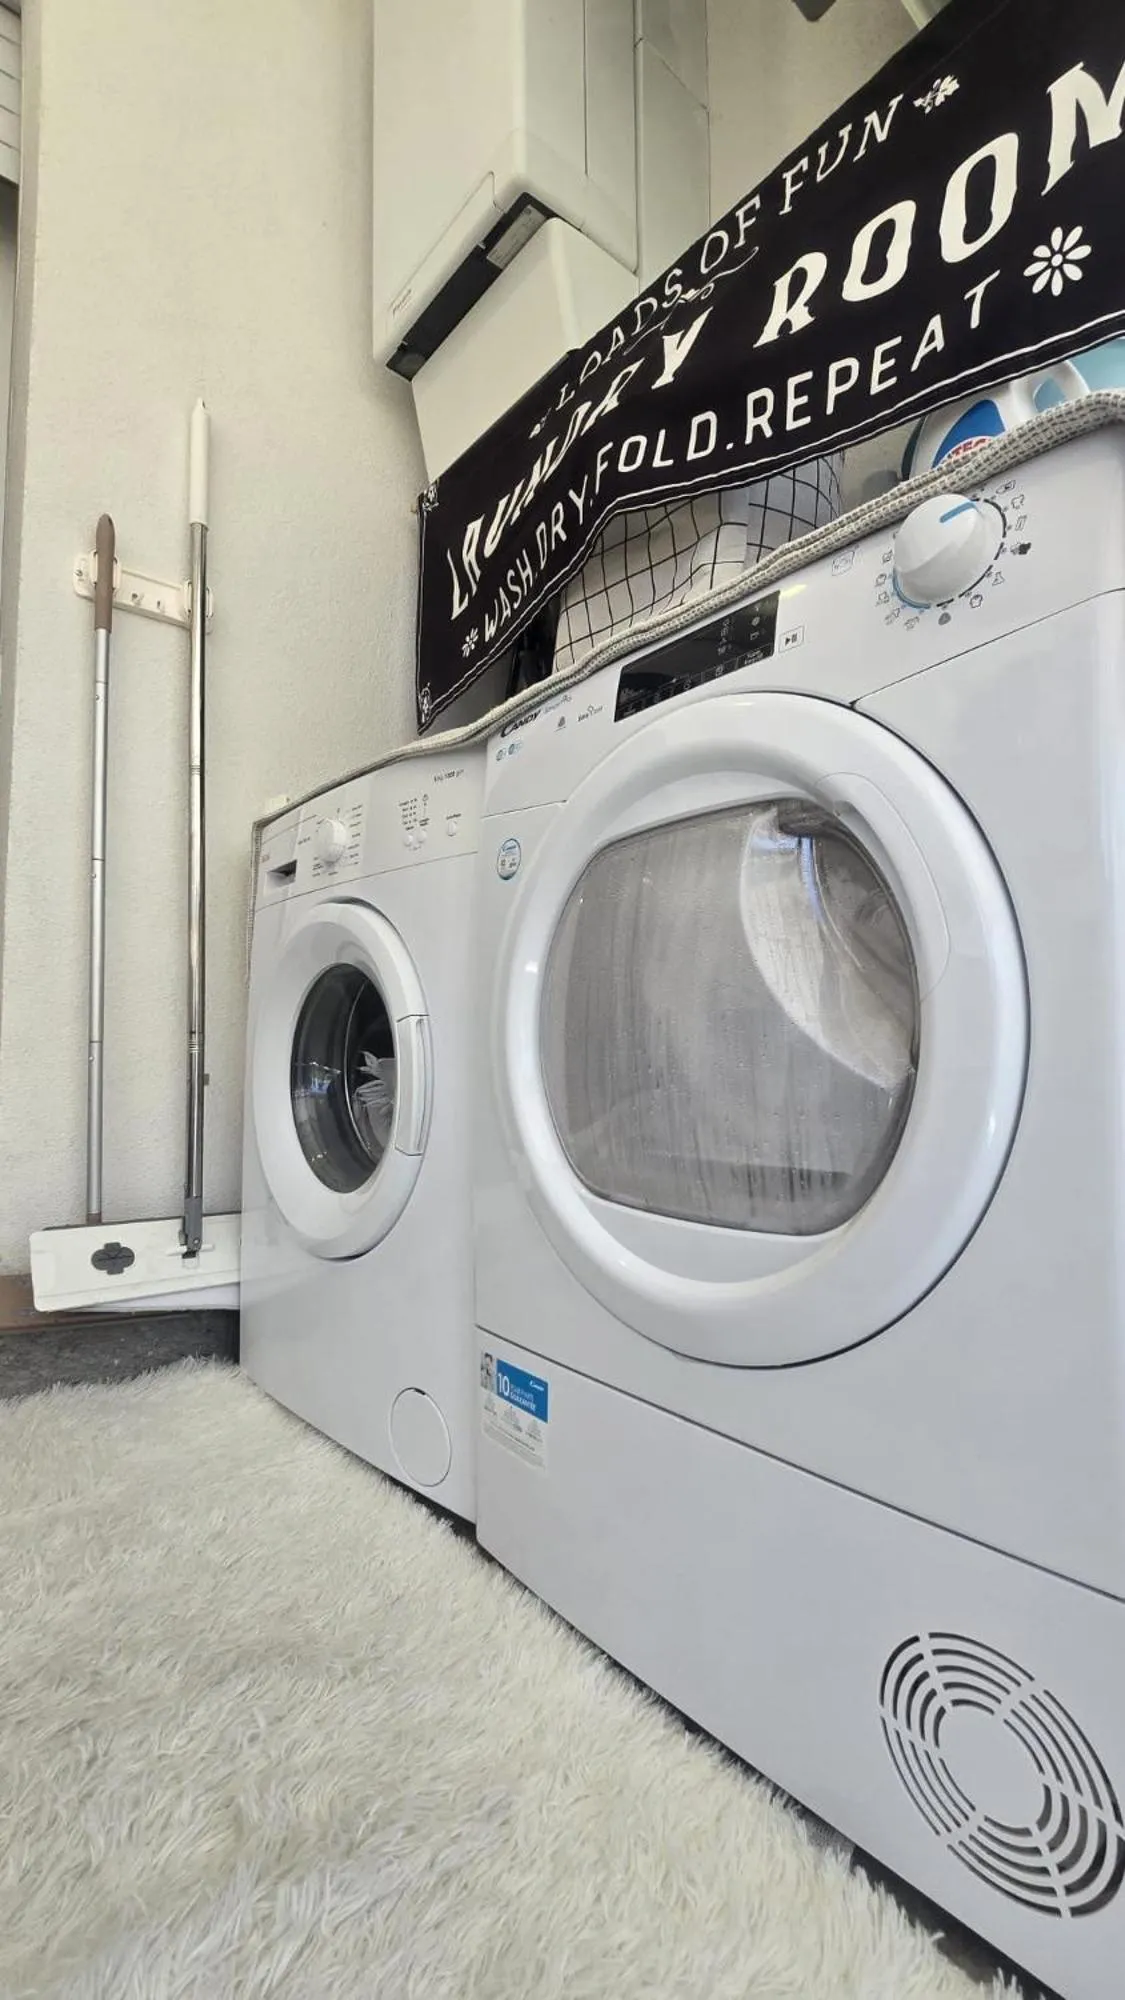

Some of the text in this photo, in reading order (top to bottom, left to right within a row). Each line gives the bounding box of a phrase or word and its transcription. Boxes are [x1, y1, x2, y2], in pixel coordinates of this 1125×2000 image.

[556, 94, 904, 410] LOADS OF FUN
[447, 62, 1125, 620] LAUNDRY ROOM
[501, 710, 541, 738] CANDY
[498, 1372, 510, 1397] 10
